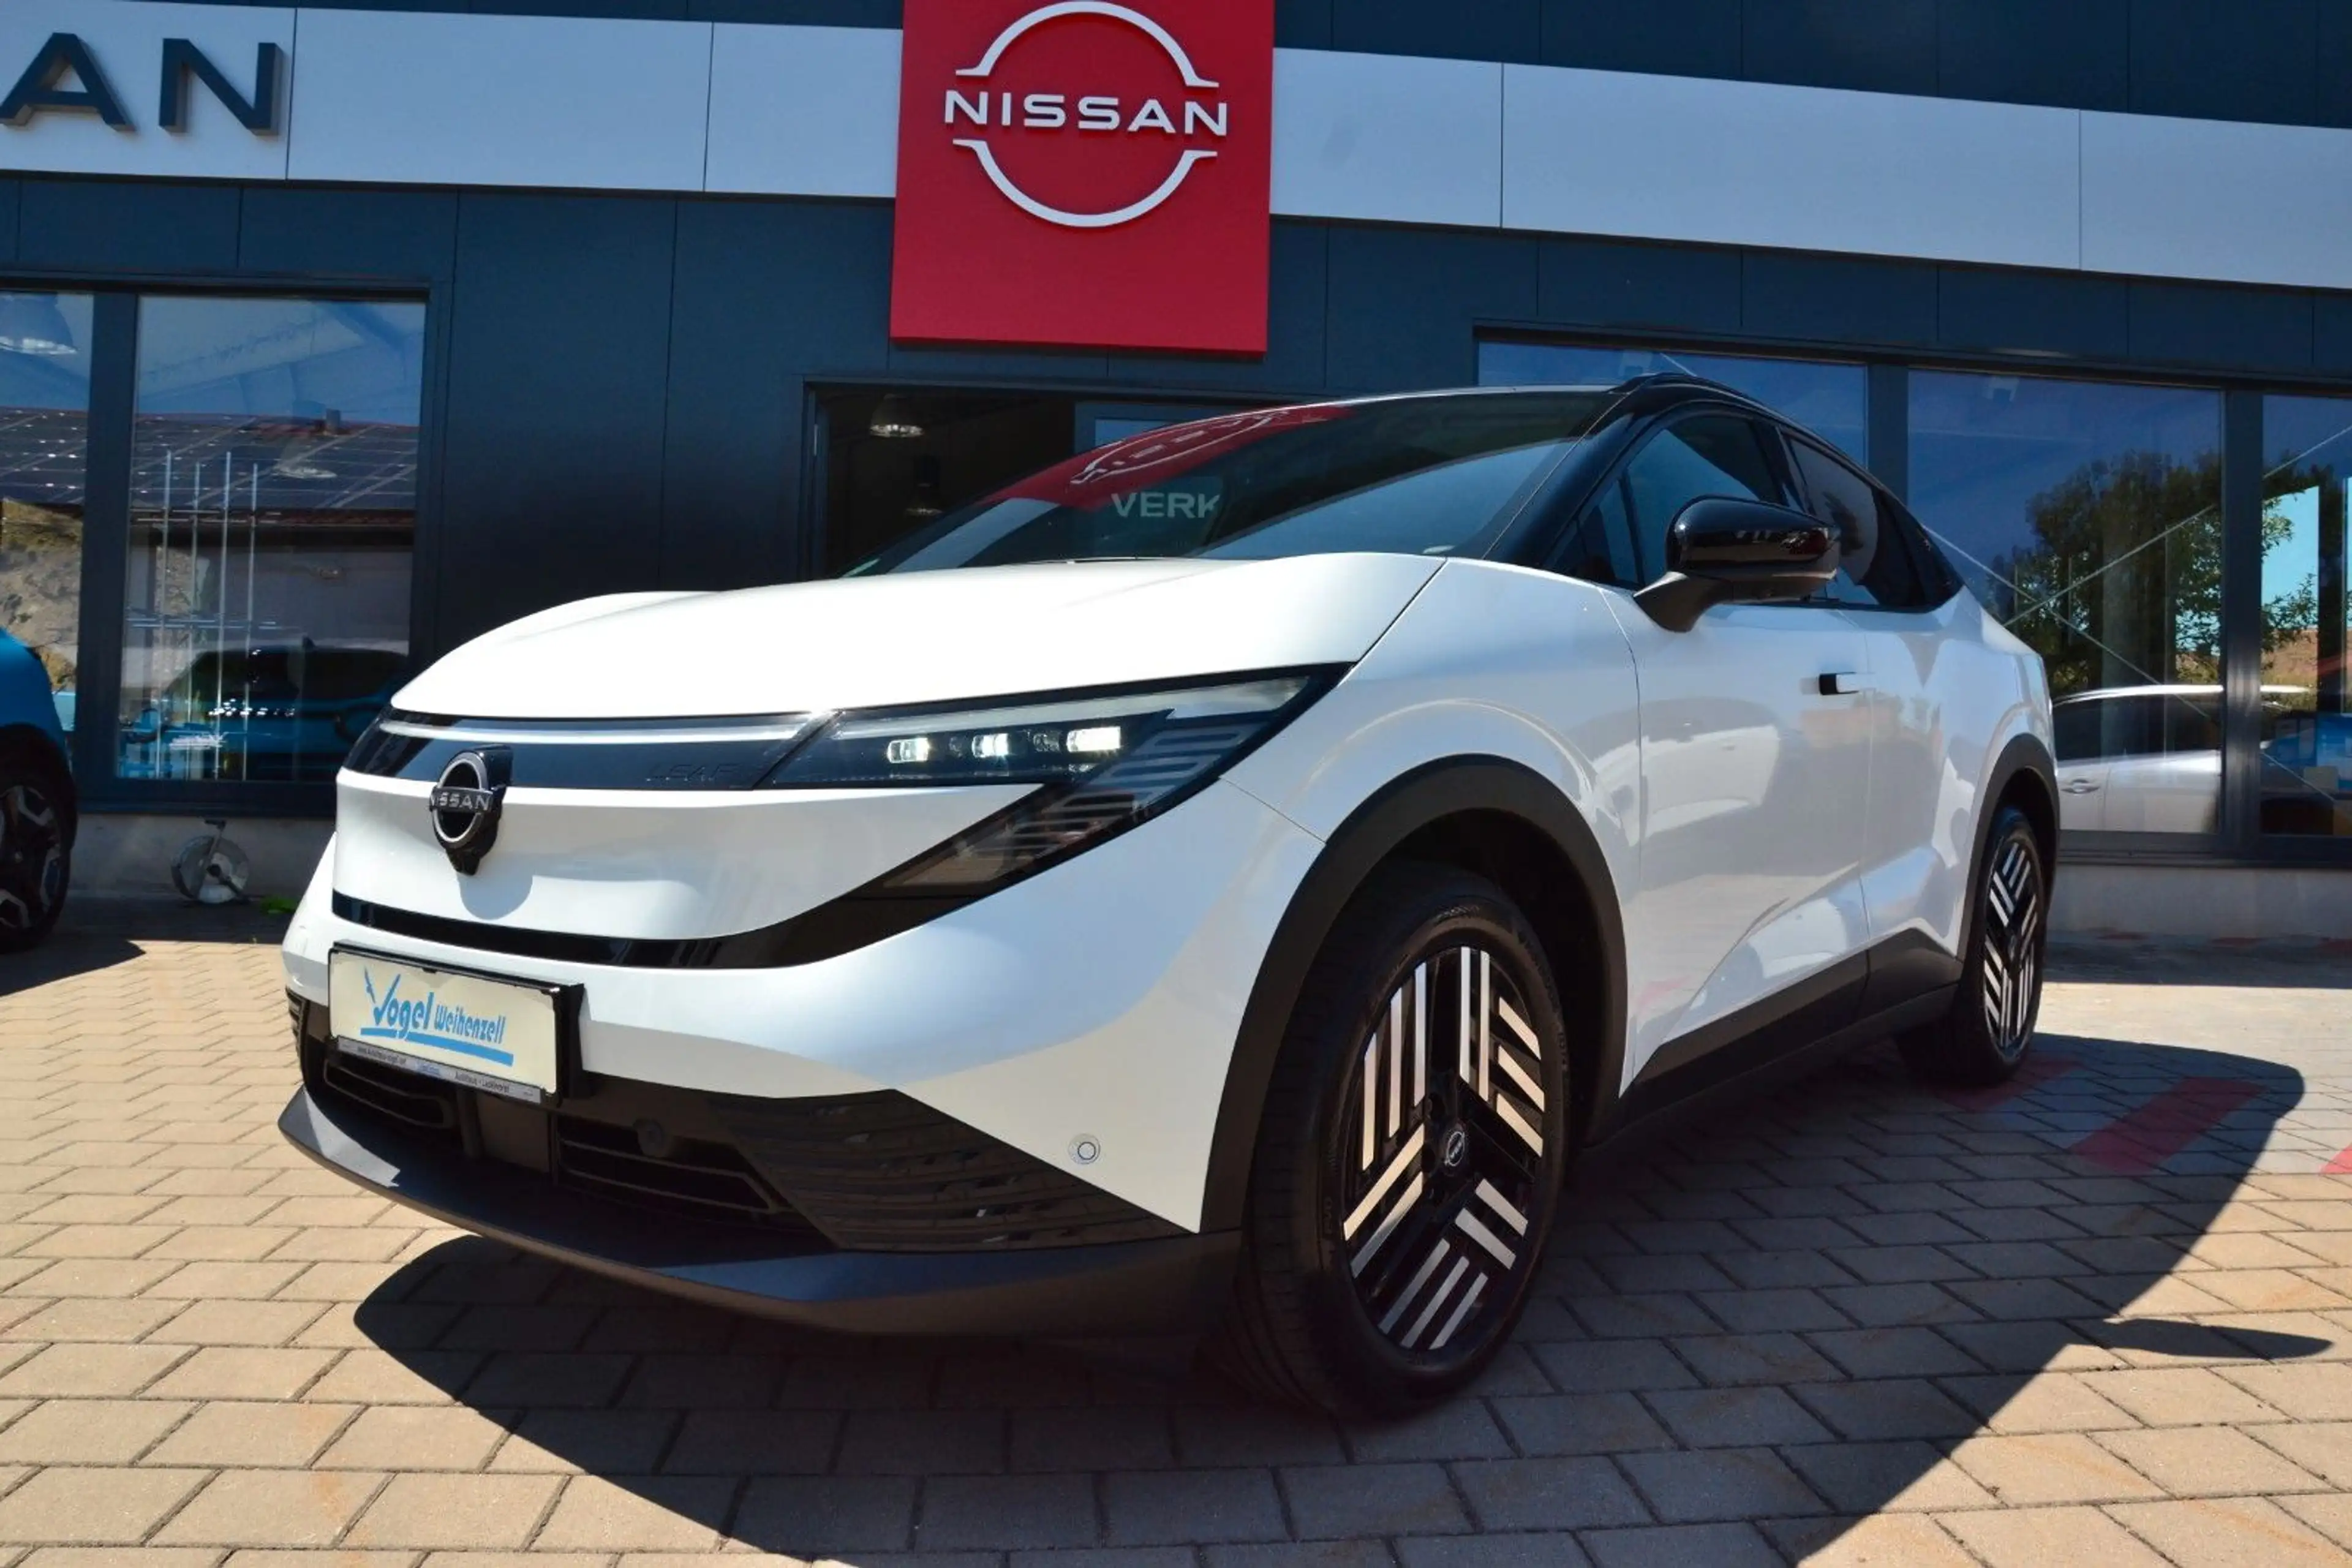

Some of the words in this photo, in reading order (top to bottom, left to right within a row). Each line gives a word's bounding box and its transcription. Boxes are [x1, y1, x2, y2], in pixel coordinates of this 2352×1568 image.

[0, 32, 282, 134] AN
[944, 90, 1227, 137] NISSAN
[1110, 492, 1221, 518] VERK
[364, 965, 435, 1039] Vogel
[434, 1004, 506, 1044] Weihenzell
